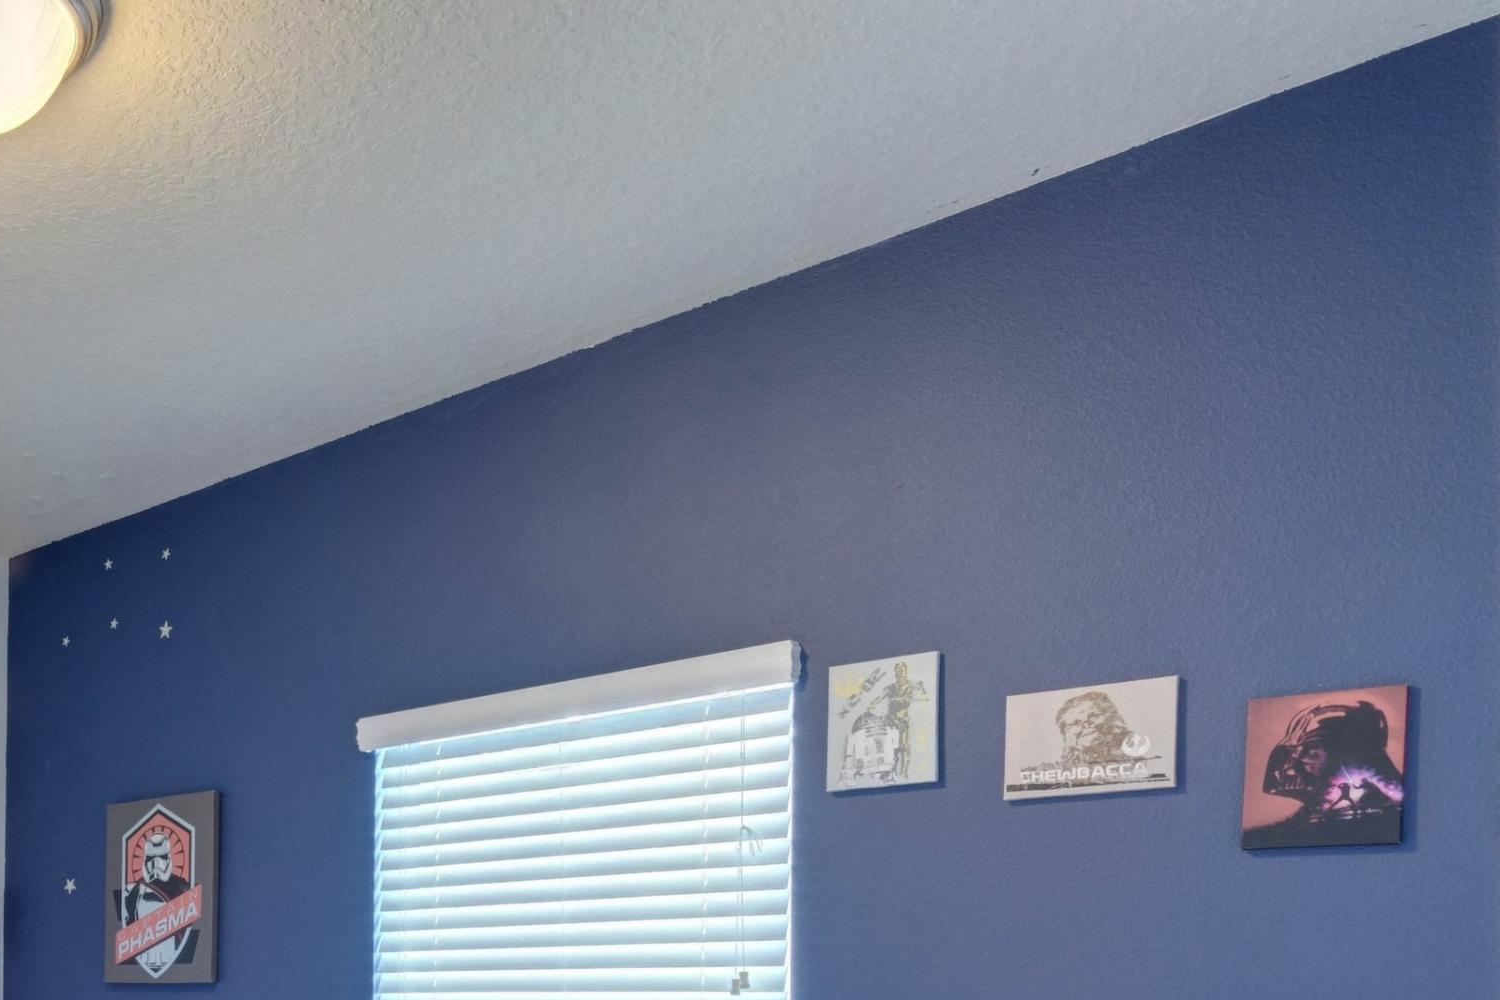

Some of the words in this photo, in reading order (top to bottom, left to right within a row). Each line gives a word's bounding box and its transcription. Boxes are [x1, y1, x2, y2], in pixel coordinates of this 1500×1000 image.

[1020, 762, 1148, 784] CHEWBACCA
[118, 889, 199, 942] CAPTAIN
[118, 902, 198, 960] PHASMA
